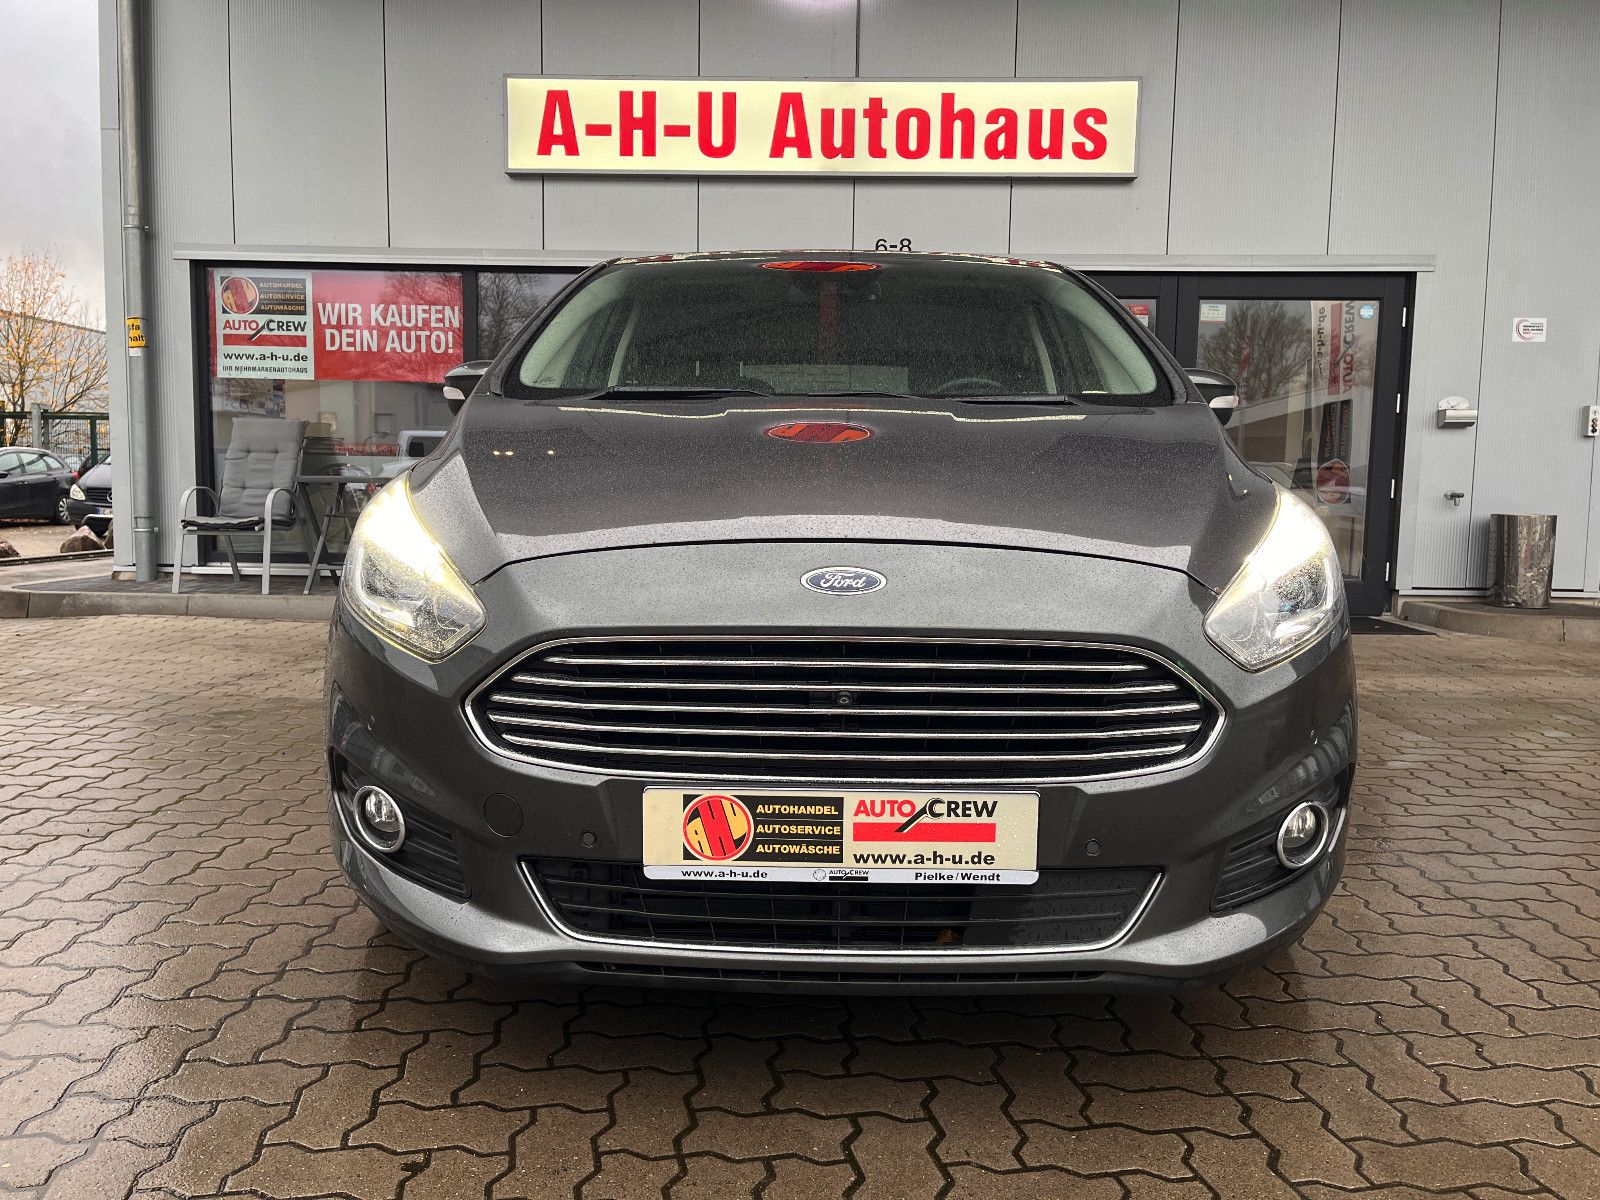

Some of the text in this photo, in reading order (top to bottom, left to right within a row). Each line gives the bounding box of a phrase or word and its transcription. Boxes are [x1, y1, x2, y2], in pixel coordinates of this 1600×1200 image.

[536, 89, 1109, 160] A-H-U Autohaus
[875, 238, 912, 251] 6-8
[317, 302, 460, 328] WIR KAUFEN
[223, 319, 307, 332] AUTO CREW
[325, 328, 454, 354] DEIN AUTO!
[223, 351, 308, 362] www.a-h-u.de
[235, 365, 308, 374] MEHRMARKENAUTOHAUS
[820, 572, 867, 589] Ford
[756, 804, 839, 815] AUTOHANDEL
[853, 798, 998, 819] AUTO CREW
[756, 824, 841, 835] AUTOSERVICE
[756, 843, 841, 855] AUTOWÄSCHE
[853, 850, 996, 866] www.a-h-u.de
[681, 869, 768, 879] www.a-h-u.de
